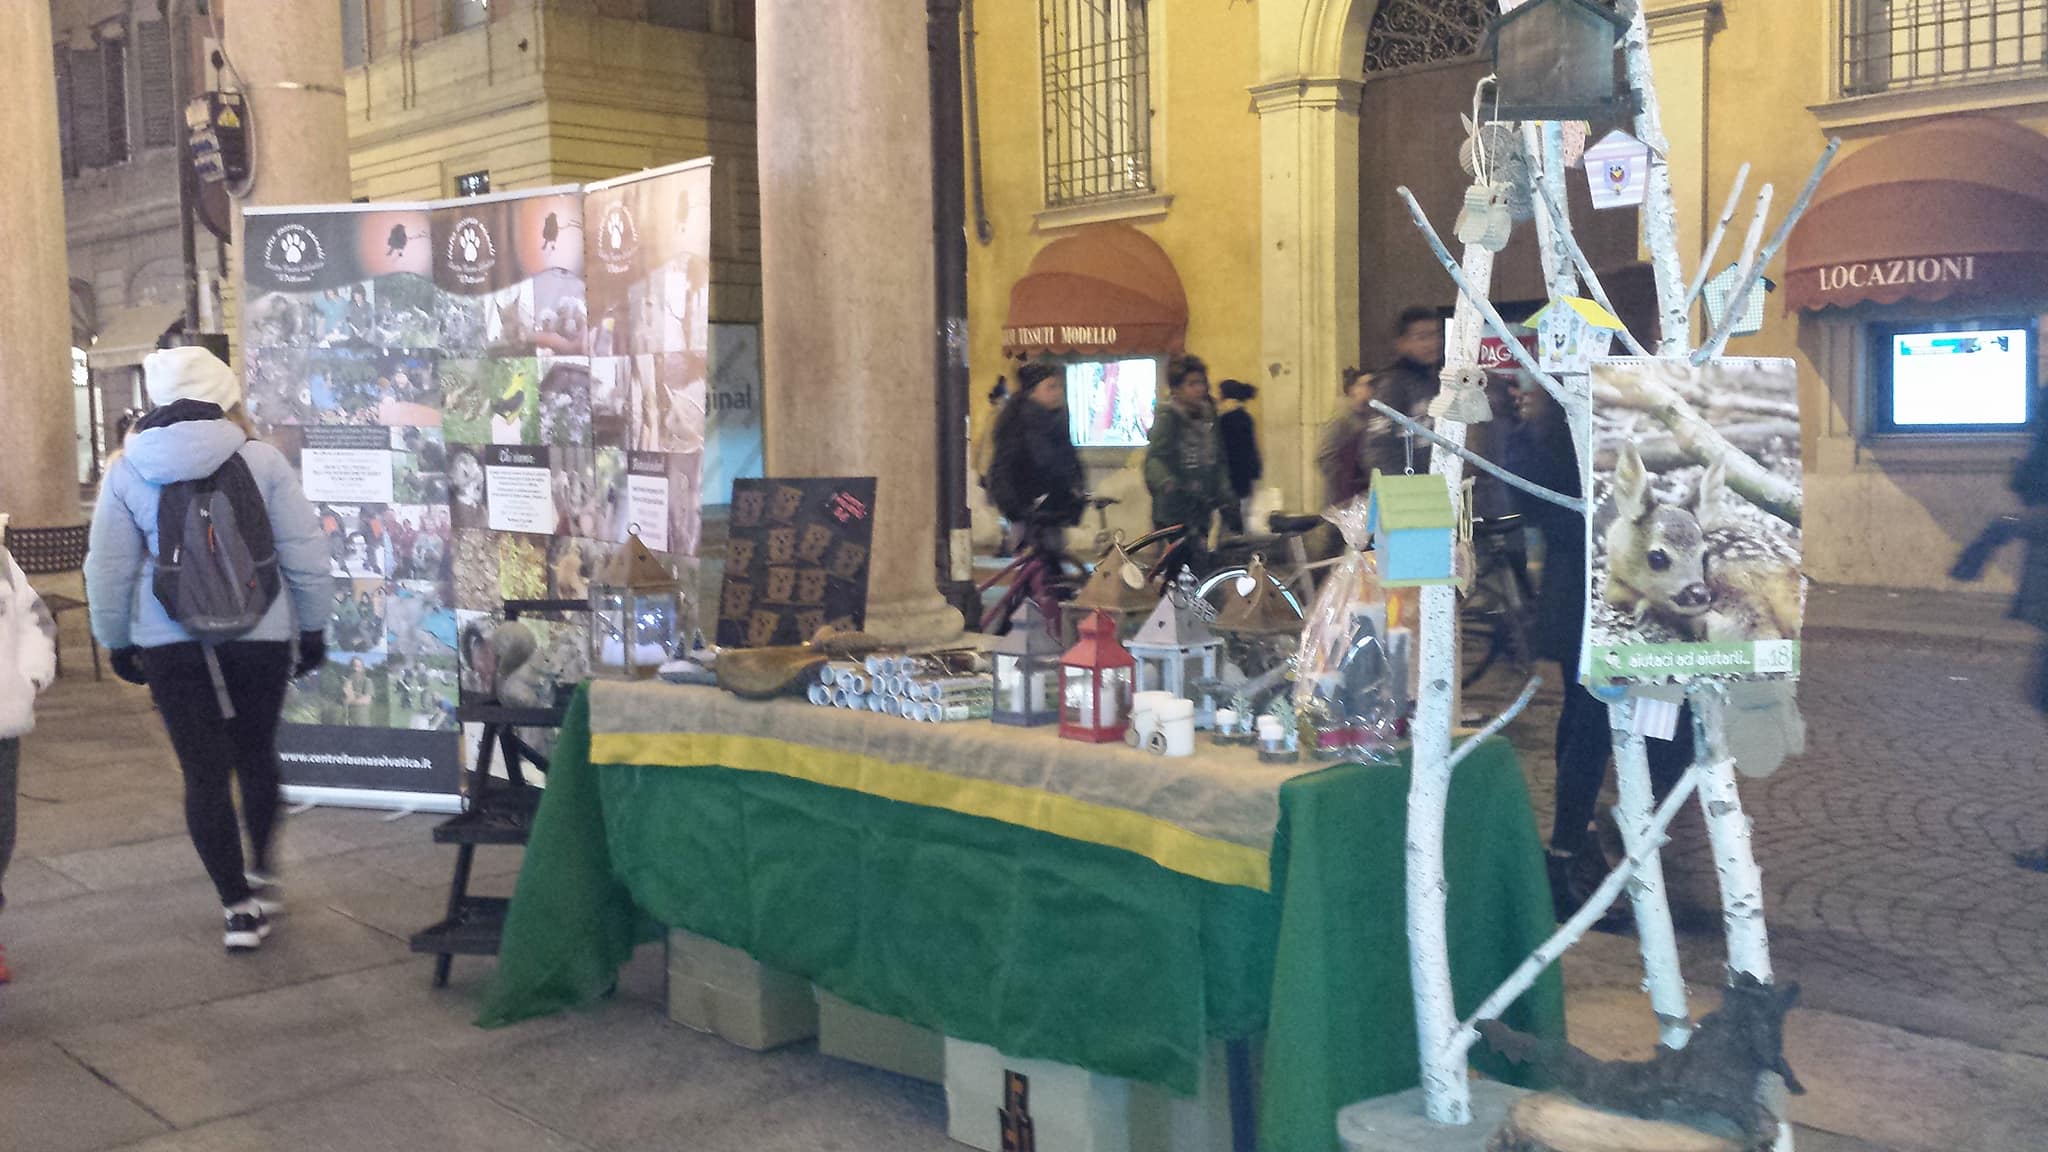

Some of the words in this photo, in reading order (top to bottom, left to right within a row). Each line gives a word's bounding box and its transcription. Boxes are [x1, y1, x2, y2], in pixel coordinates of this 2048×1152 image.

[1818, 255, 1975, 291] LOCAZIONI
[1060, 326, 1117, 345] MODELLO
[1629, 652, 1673, 668] aiutaci
[1676, 652, 1695, 666] ad
